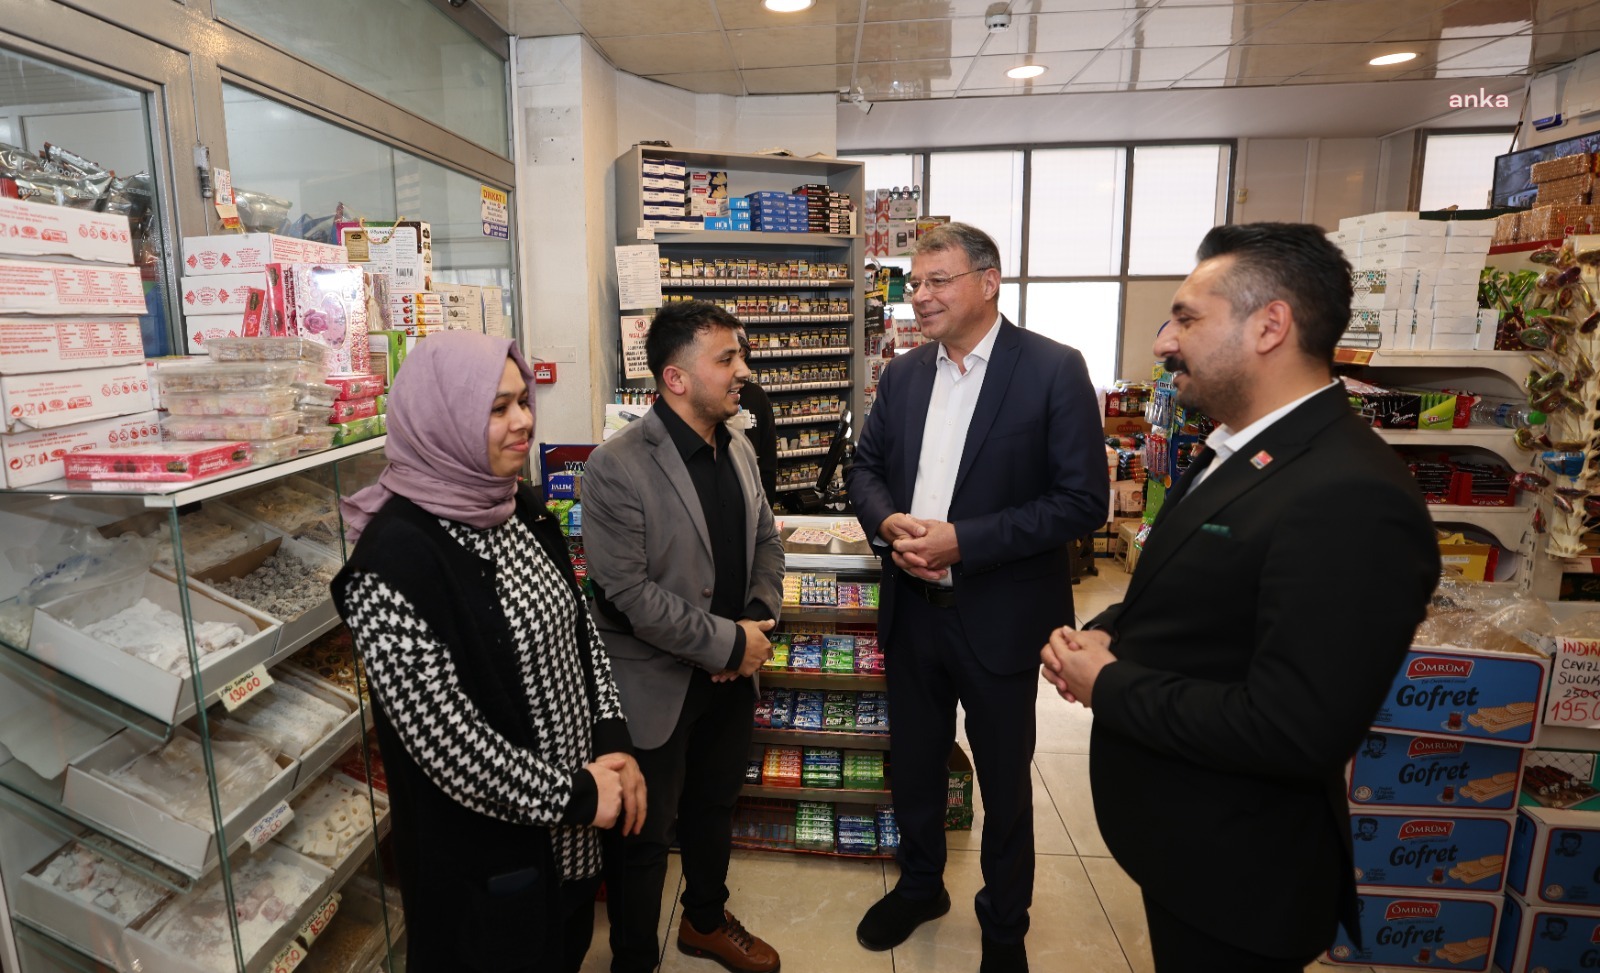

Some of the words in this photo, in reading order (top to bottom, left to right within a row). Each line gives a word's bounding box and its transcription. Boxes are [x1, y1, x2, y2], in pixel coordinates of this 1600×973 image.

[1563, 639, 1600, 656] İNDİR
[1414, 661, 1464, 672] ÖMRÜM
[230, 677, 260, 702] 130.00
[1396, 685, 1480, 711] Gofret
[1414, 740, 1458, 750] ÖMRÜM
[1398, 761, 1470, 786] Gofret
[1405, 825, 1447, 834] ÖMRÜM
[1390, 844, 1458, 868] Gofret
[1391, 905, 1433, 914] ÖMRÜM
[1376, 925, 1446, 948] Gofret
